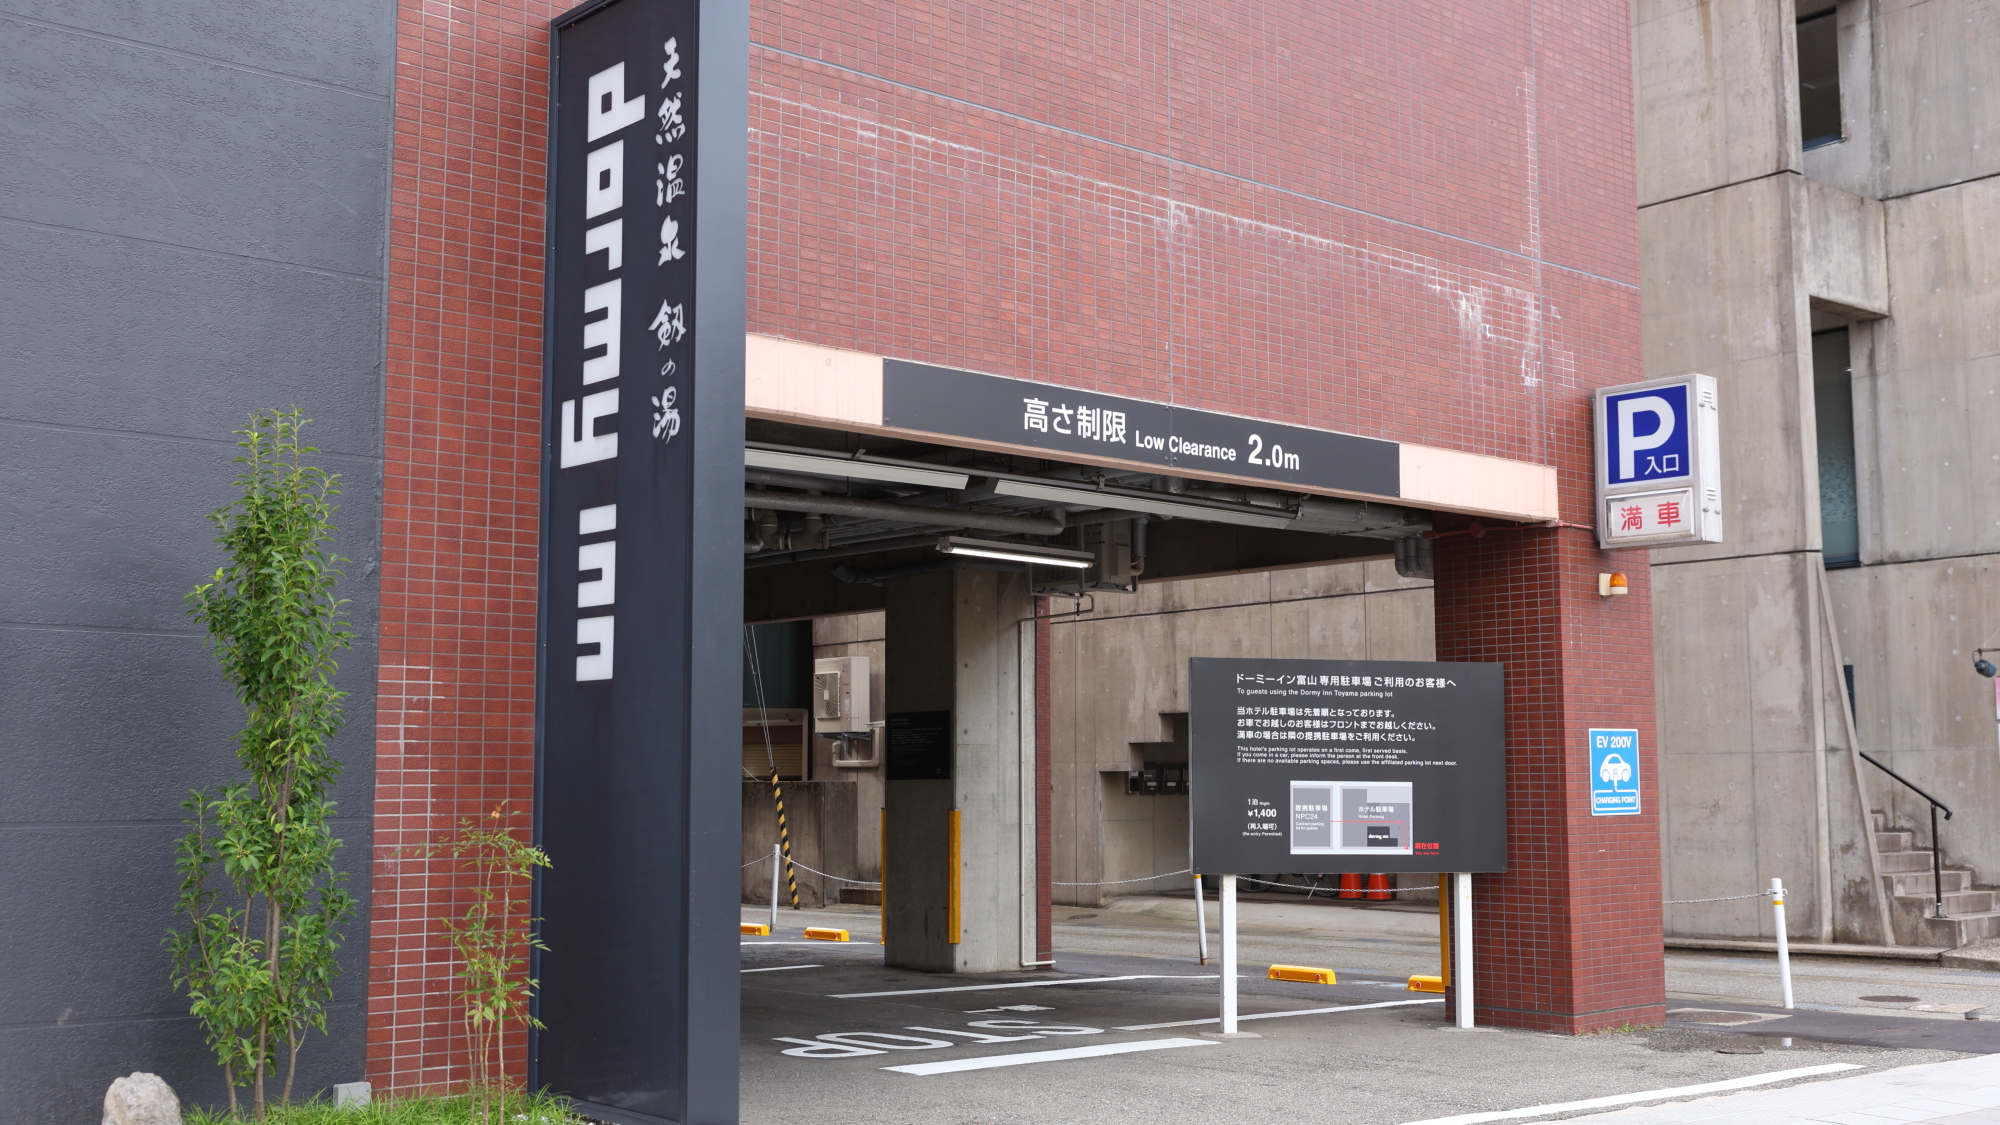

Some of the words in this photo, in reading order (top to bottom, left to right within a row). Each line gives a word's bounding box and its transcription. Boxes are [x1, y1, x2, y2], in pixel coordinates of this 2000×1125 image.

[655, 36, 687, 267] 天然温泉
[1023, 397, 1127, 445] 高さ制限
[1135, 430, 1164, 451] Low
[1168, 435, 1237, 462] Clearance
[1247, 433, 1300, 471] 2.0m
[1617, 395, 1676, 480] P
[1644, 453, 1680, 476] 入口
[1620, 501, 1681, 531] 満車
[1236, 673, 1317, 686] ドーミーイン富山
[1319, 675, 1372, 686] 専用駐車場
[1374, 676, 1456, 688] ご利用のお客様へ
[1596, 736, 1608, 748] EV
[1610, 736, 1632, 748] 200V
[1248, 808, 1277, 818] ¥1,400
[1621, 796, 1636, 804] POINT
[771, 1019, 1105, 1058] STOP
